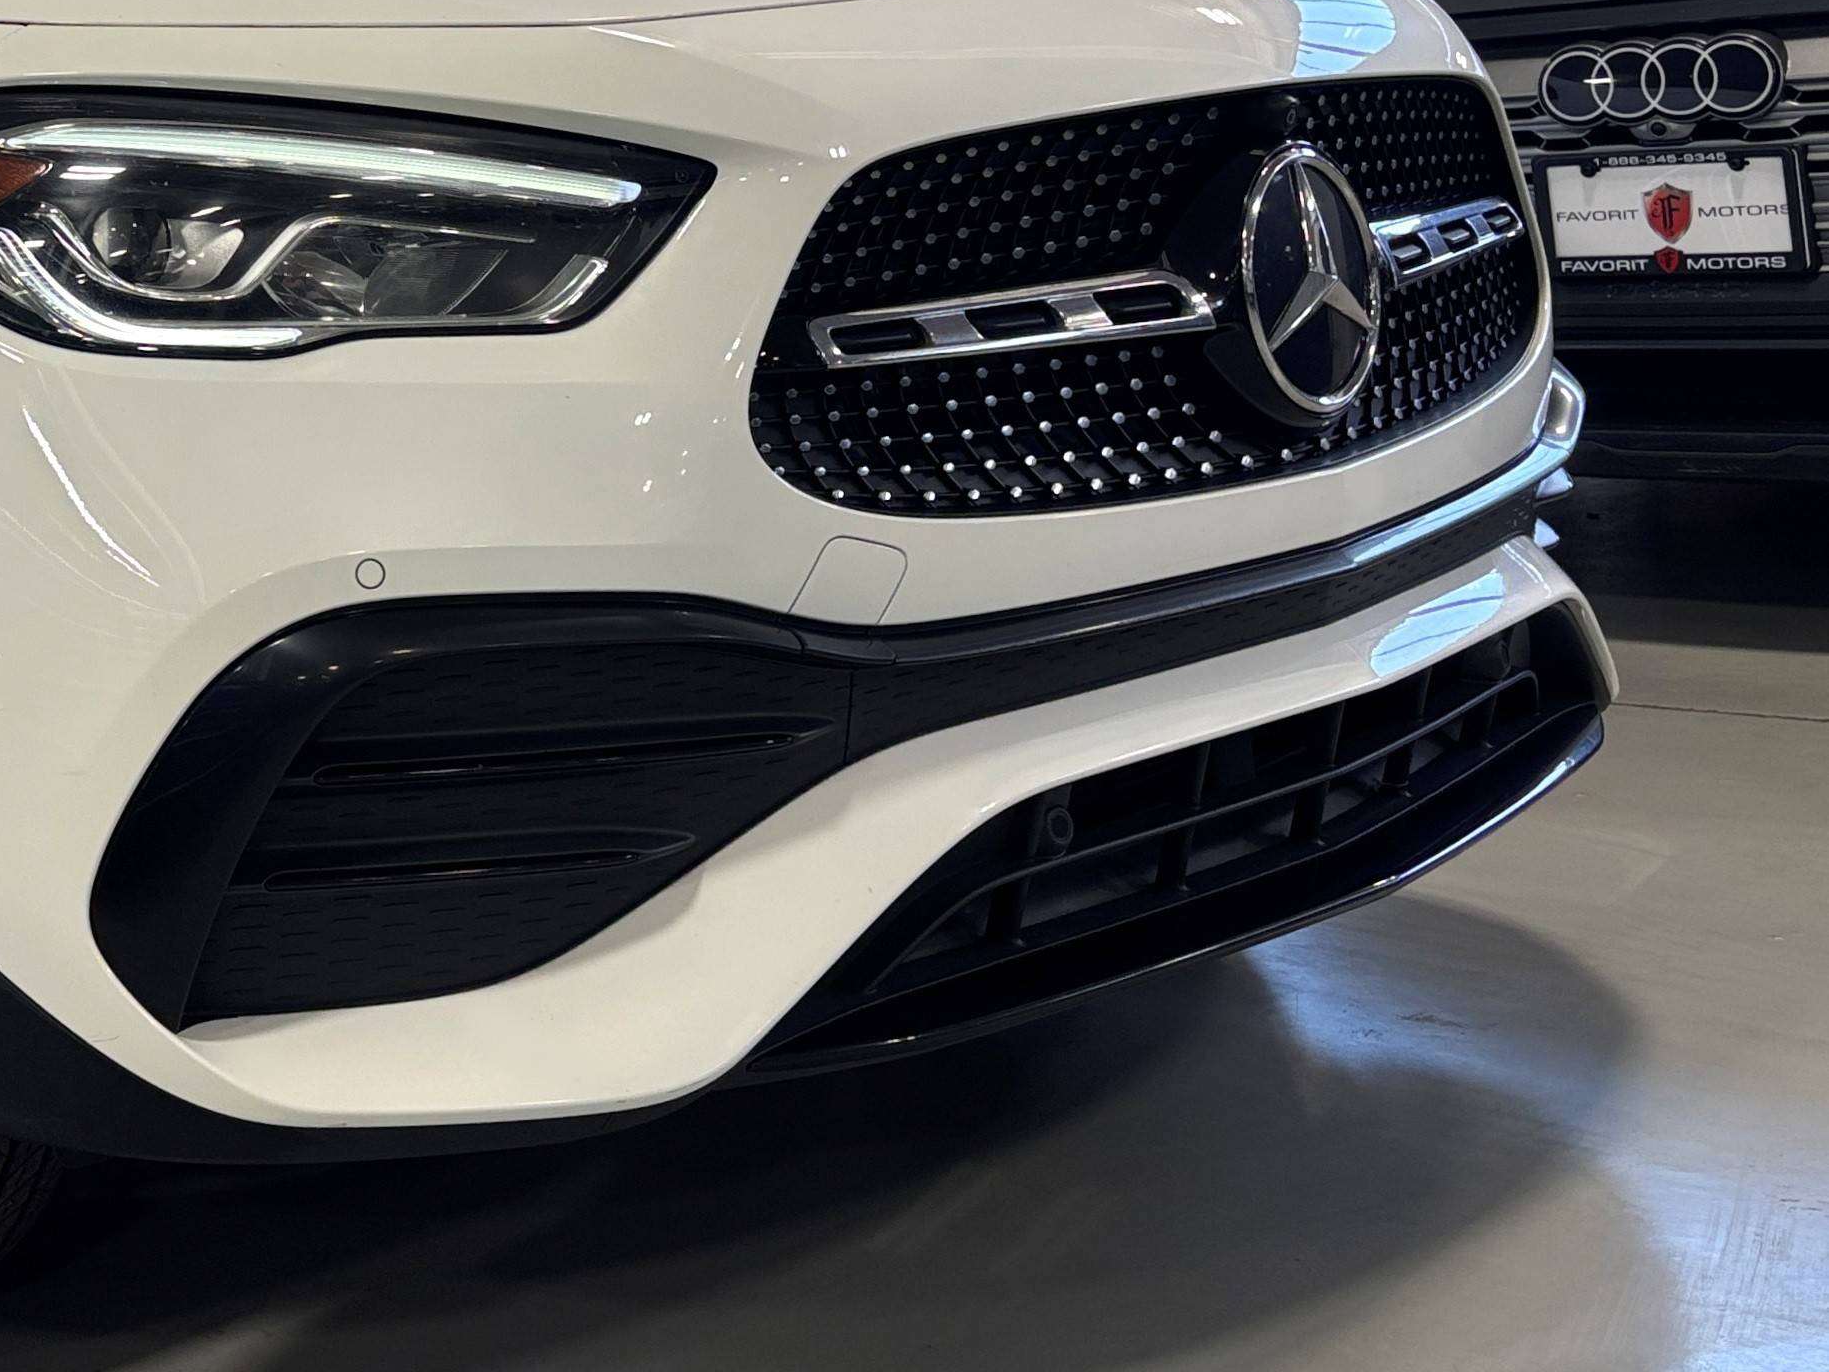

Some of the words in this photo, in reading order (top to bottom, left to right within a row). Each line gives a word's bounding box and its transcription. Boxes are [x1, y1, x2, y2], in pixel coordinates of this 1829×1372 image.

[1556, 208, 1639, 223] FAVORIT
[1697, 203, 1789, 218] MOTORS
[1560, 258, 1649, 273] FAVORIT
[1687, 256, 1787, 271] MOTORS
